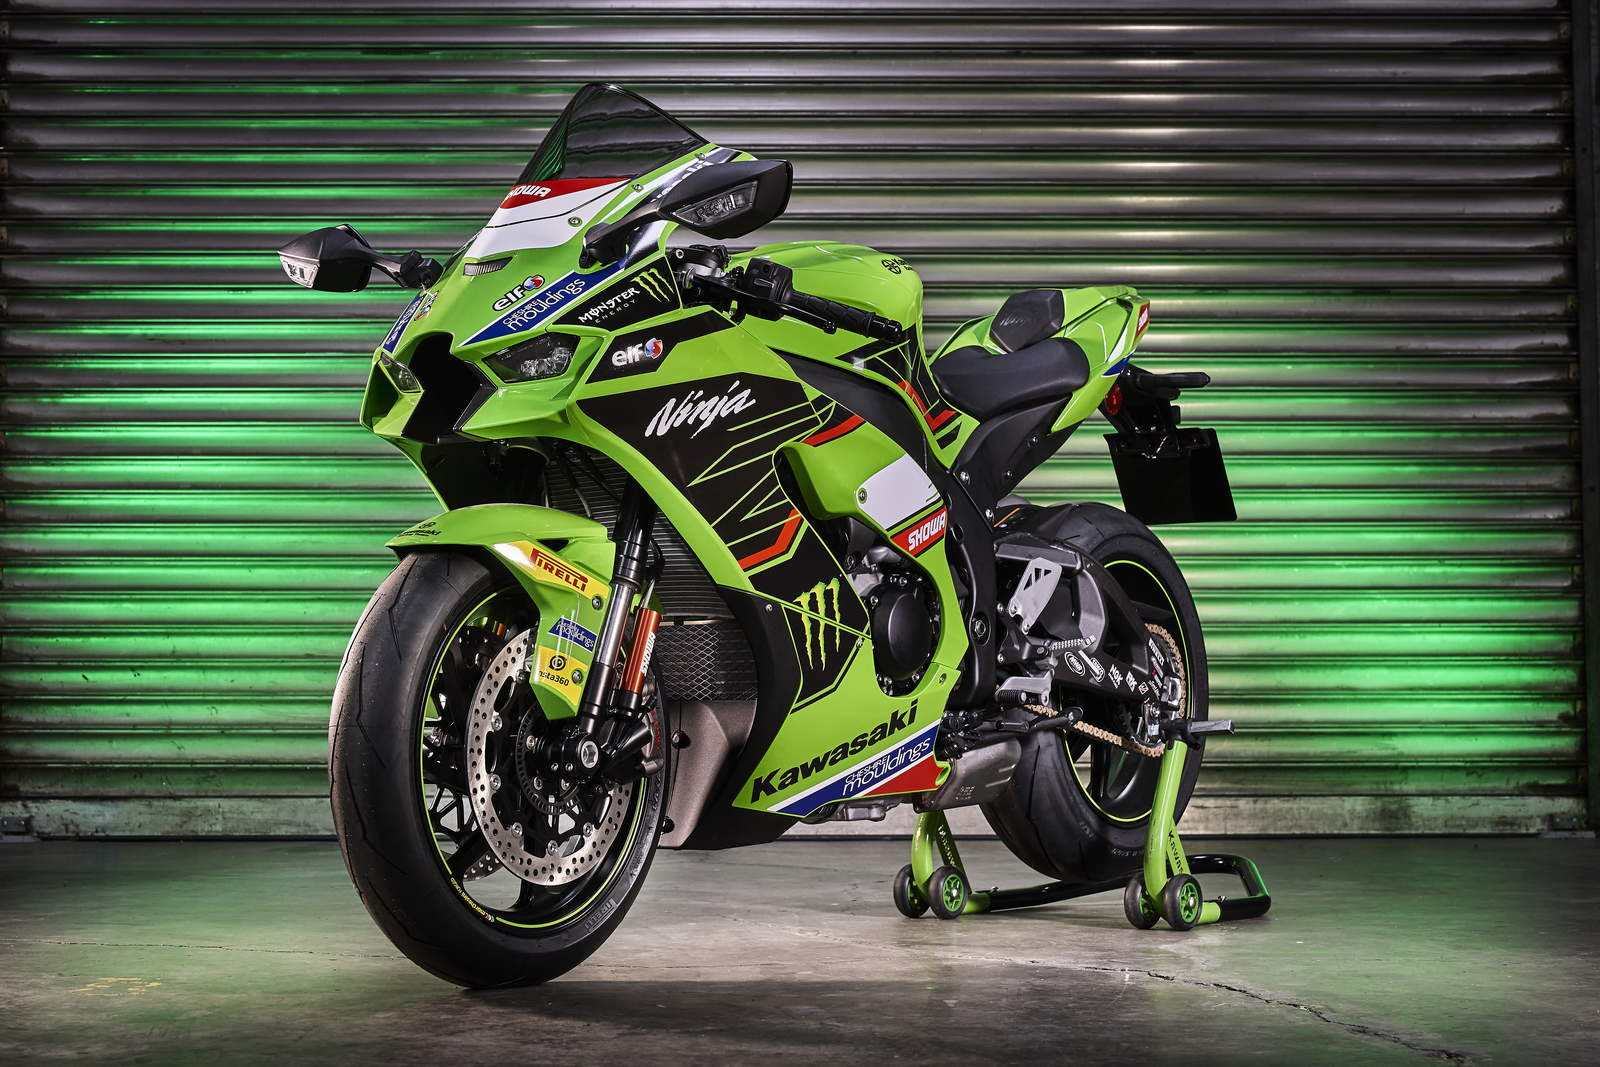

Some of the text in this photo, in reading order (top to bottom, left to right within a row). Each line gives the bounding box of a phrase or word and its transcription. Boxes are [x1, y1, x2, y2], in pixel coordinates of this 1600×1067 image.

[493, 286, 525, 311] elf
[507, 279, 586, 331] mouldings
[578, 287, 640, 323] MONSTER
[595, 300, 635, 323] ENERGY
[611, 343, 643, 366] elf
[645, 380, 756, 439] Ninja
[908, 511, 946, 551] SHOWA
[530, 548, 589, 592] PIRELLI
[537, 670, 570, 687] nsta360
[751, 700, 918, 803] Kawasaki
[842, 738, 931, 796] mouldings
[845, 756, 889, 784] CHESHIRE
